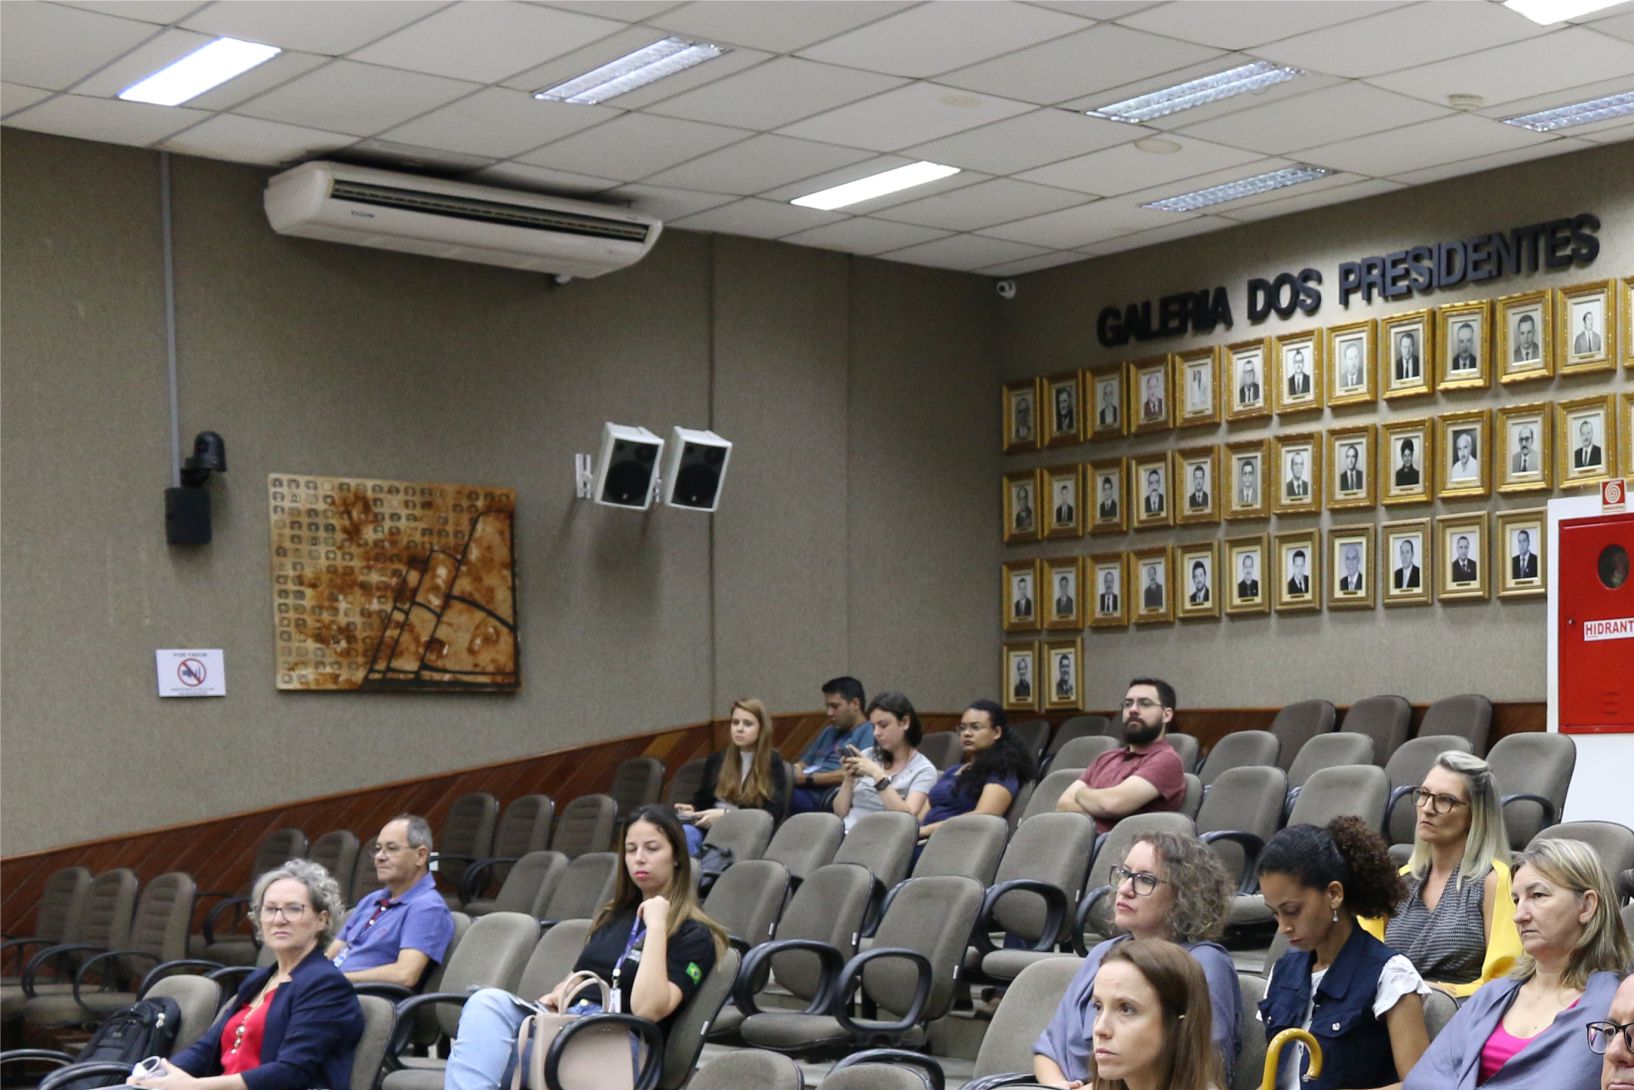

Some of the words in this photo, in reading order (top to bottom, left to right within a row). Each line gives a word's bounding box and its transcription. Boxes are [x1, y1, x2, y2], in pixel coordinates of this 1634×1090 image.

[1097, 286, 1233, 348] GALERIA
[1247, 267, 1323, 320] DOS
[1338, 212, 1601, 309] PRESIDENTES
